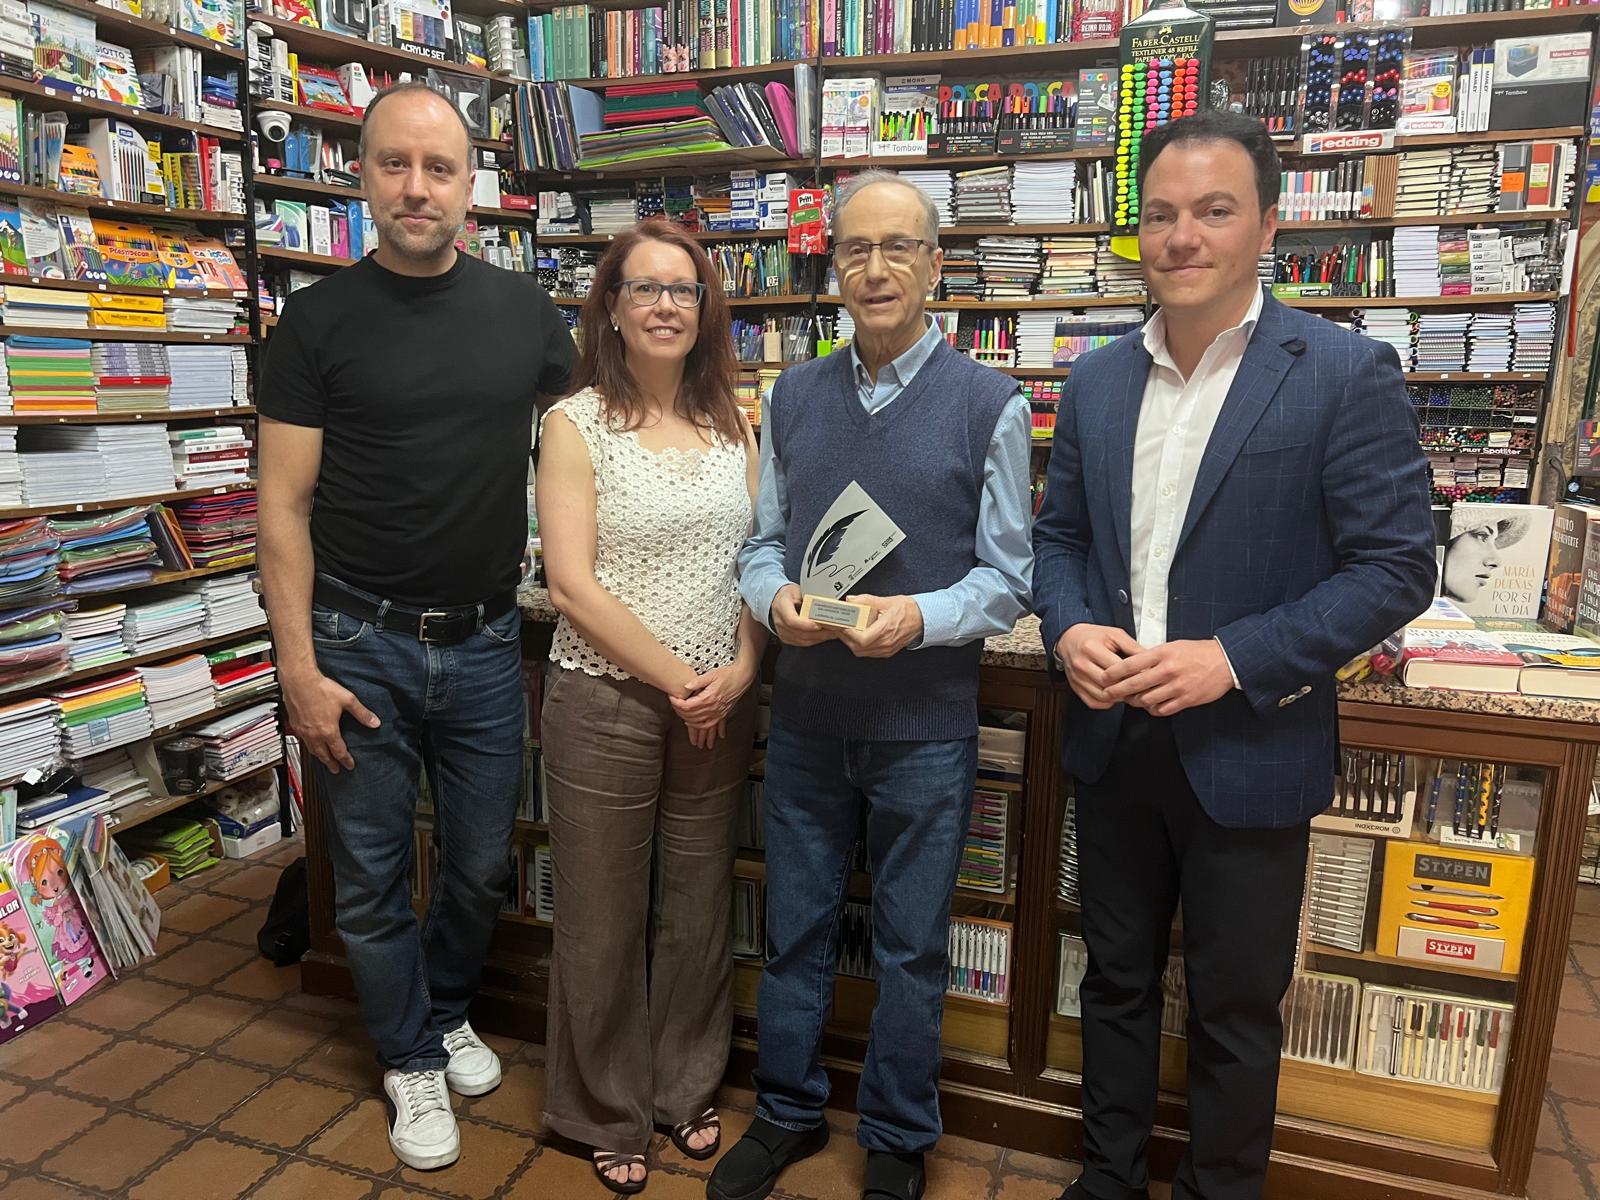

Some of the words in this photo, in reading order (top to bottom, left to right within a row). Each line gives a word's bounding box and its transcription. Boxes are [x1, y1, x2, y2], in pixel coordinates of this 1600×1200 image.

[1132, 35, 1200, 48] FABER-CASTELL
[400, 42, 431, 58] ACRYLIC
[430, 50, 446, 60] SET
[1132, 48, 1166, 57] TEXTLINER
[940, 81, 1002, 103] POSCA
[1009, 81, 1075, 101] POSCA
[1412, 122, 1444, 130] edding
[892, 144, 923, 152] Tombow
[1324, 136, 1380, 148] edding
[798, 195, 812, 204] Pritt
[1504, 564, 1536, 578] MARÍA
[1494, 578, 1534, 590] DUEÑAS
[1492, 590, 1518, 602] POR
[1494, 604, 1508, 614] UN
[1354, 823, 1390, 832] INOXCROM
[1418, 858, 1489, 880] STYPEN
[1429, 942, 1472, 956] STYPEN
